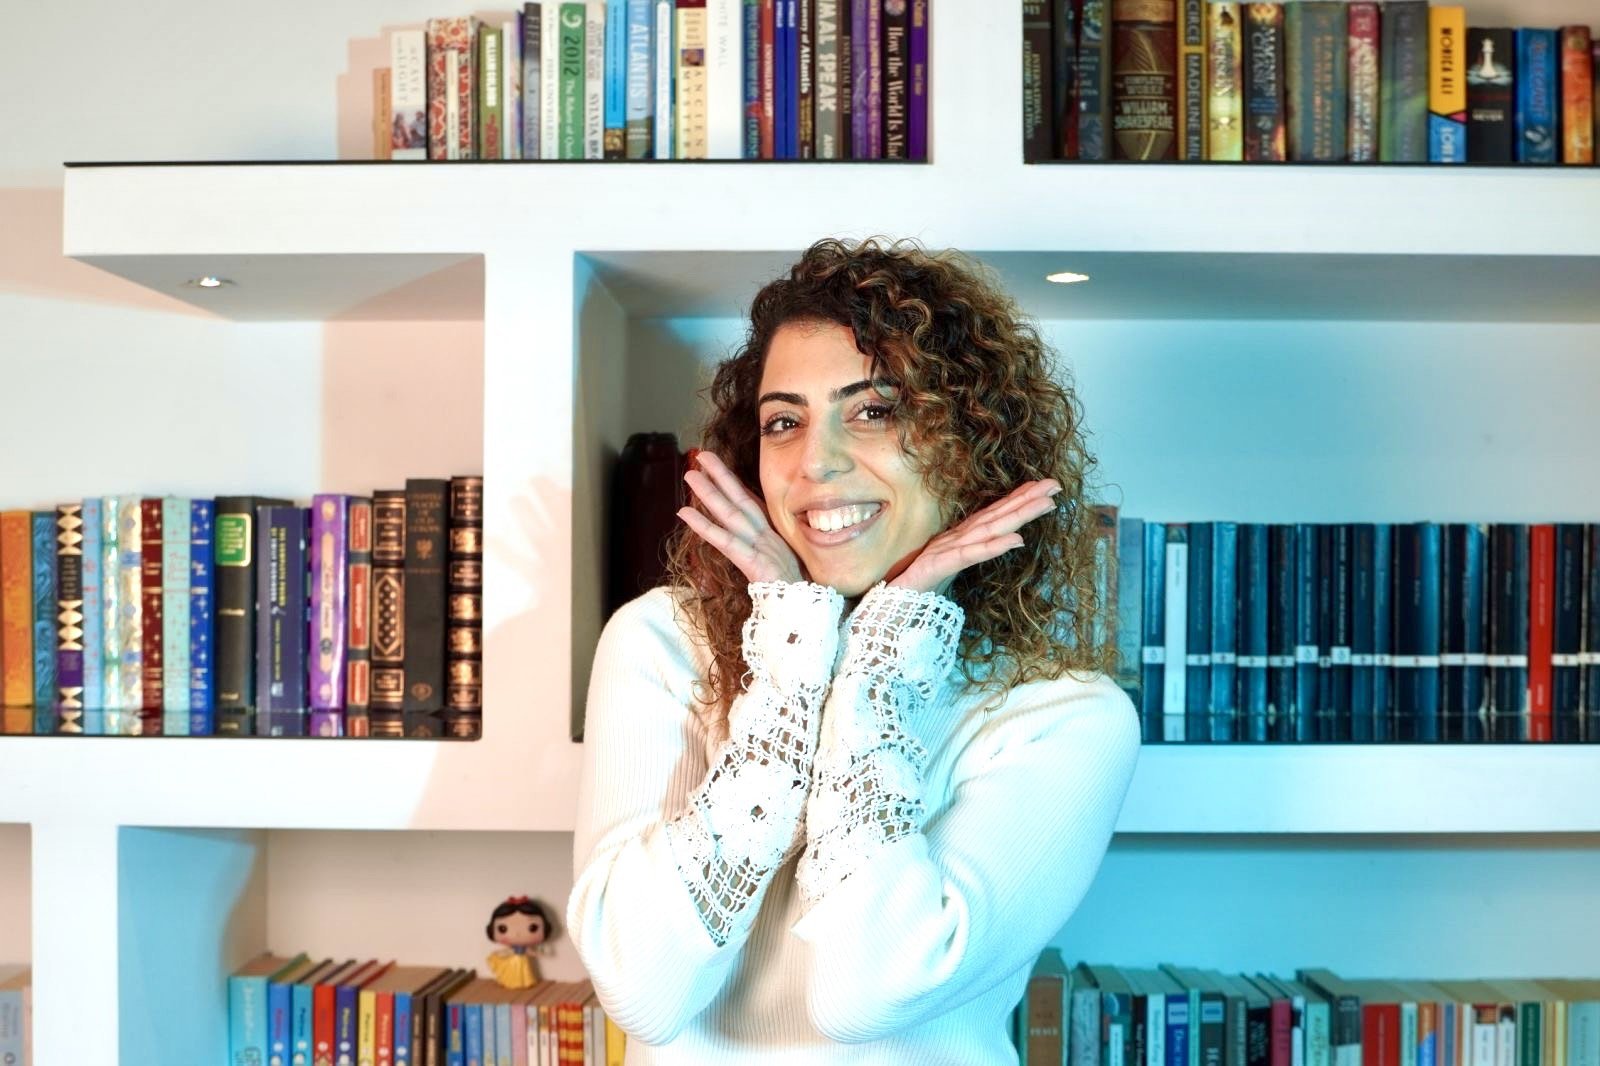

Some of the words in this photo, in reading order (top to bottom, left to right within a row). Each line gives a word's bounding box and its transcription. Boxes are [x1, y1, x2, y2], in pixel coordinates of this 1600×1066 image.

[718, 0, 728, 27] HITE
[1187, 1, 1199, 43] CIRCE
[563, 34, 581, 77] 2012
[718, 34, 728, 69] WALL
[887, 26, 904, 53] How
[1440, 27, 1454, 72] MONICA
[630, 23, 649, 98] ATLANTIS
[800, 45, 811, 94] Atlantis
[887, 57, 904, 77] the
[817, 53, 837, 113] SPEAK
[887, 80, 904, 117] World
[1187, 55, 1199, 132] MADELINE
[1440, 76, 1454, 95] ALI
[694, 70, 704, 158] ANCIEN
[887, 119, 904, 131] Is
[1115, 115, 1173, 129] SHAKESPEARE
[1121, 101, 1168, 114] WILLIAM
